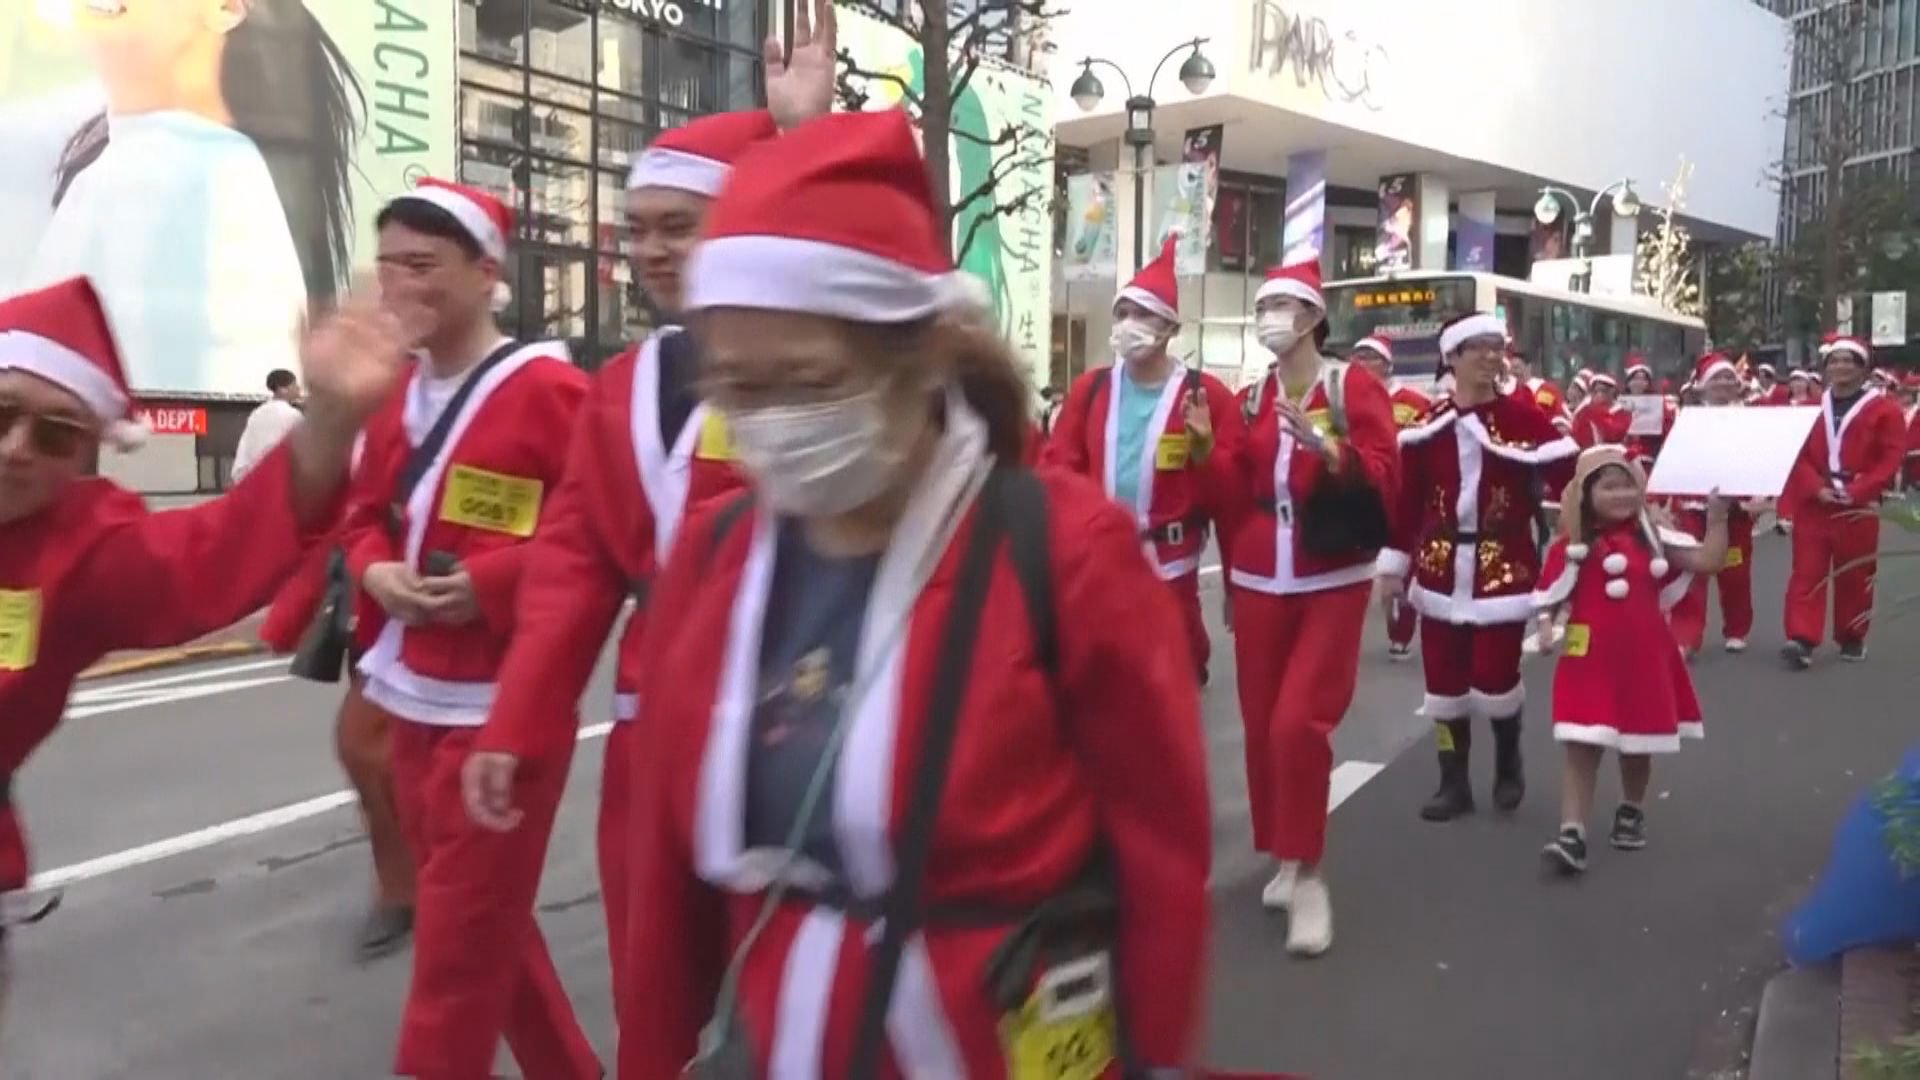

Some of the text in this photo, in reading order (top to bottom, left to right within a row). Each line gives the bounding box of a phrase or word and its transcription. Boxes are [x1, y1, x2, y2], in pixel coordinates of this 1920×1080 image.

[599, 0, 684, 26] KYO
[1020, 91, 1043, 274] NAMACHA
[157, 408, 201, 431] DEPT.
